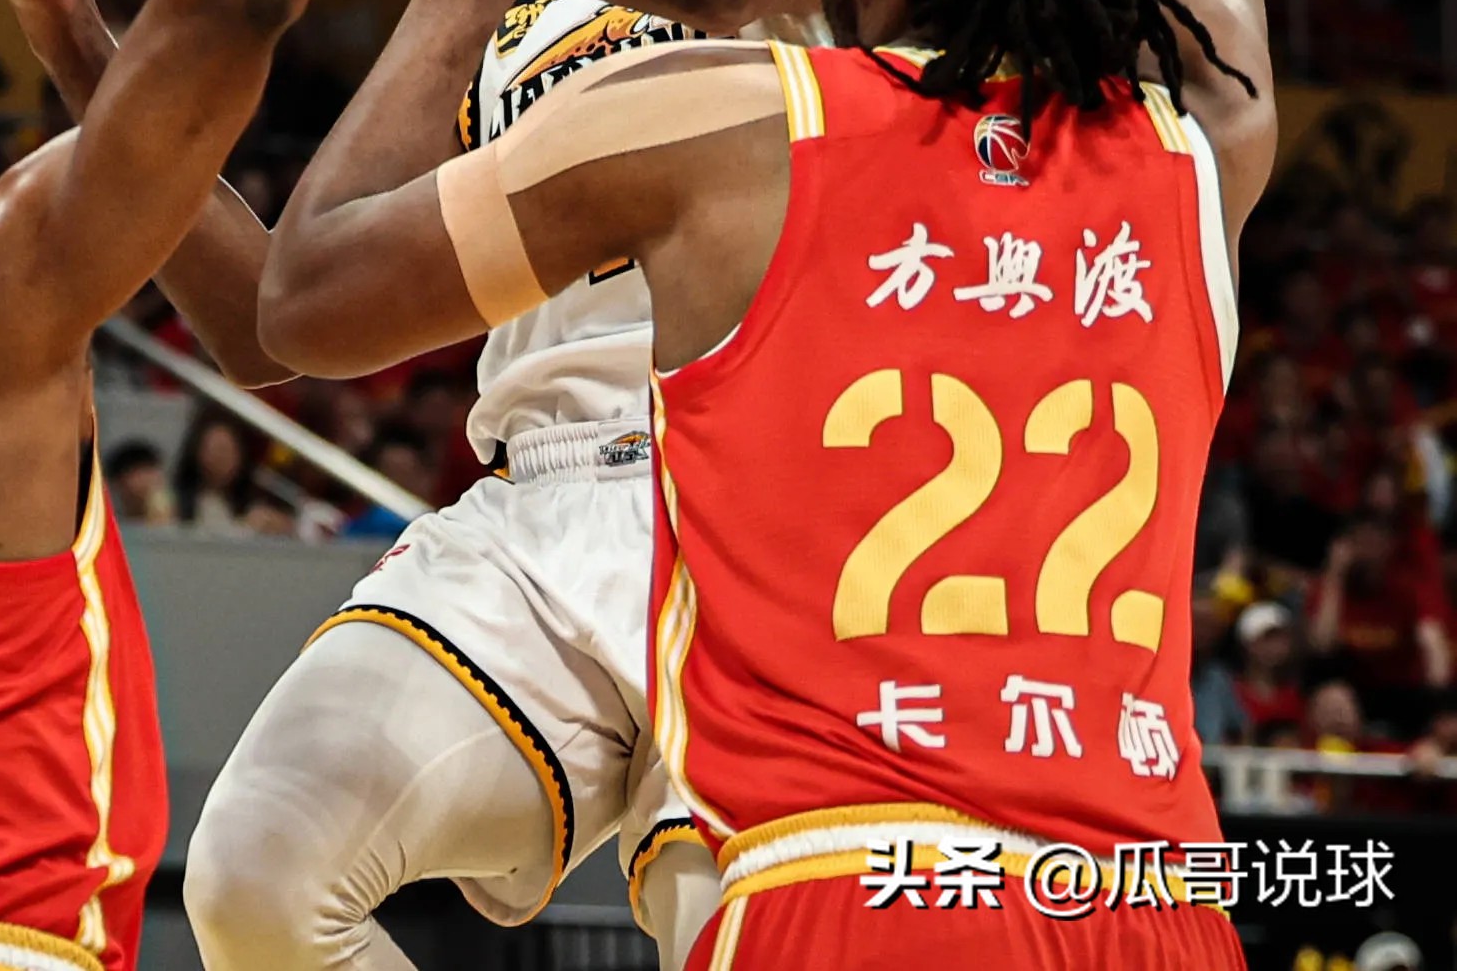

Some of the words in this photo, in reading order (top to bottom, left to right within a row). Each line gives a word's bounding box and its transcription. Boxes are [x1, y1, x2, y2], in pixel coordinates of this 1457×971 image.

[821, 367, 1167, 655] 22
[855, 673, 1181, 782] 卡尔顿
